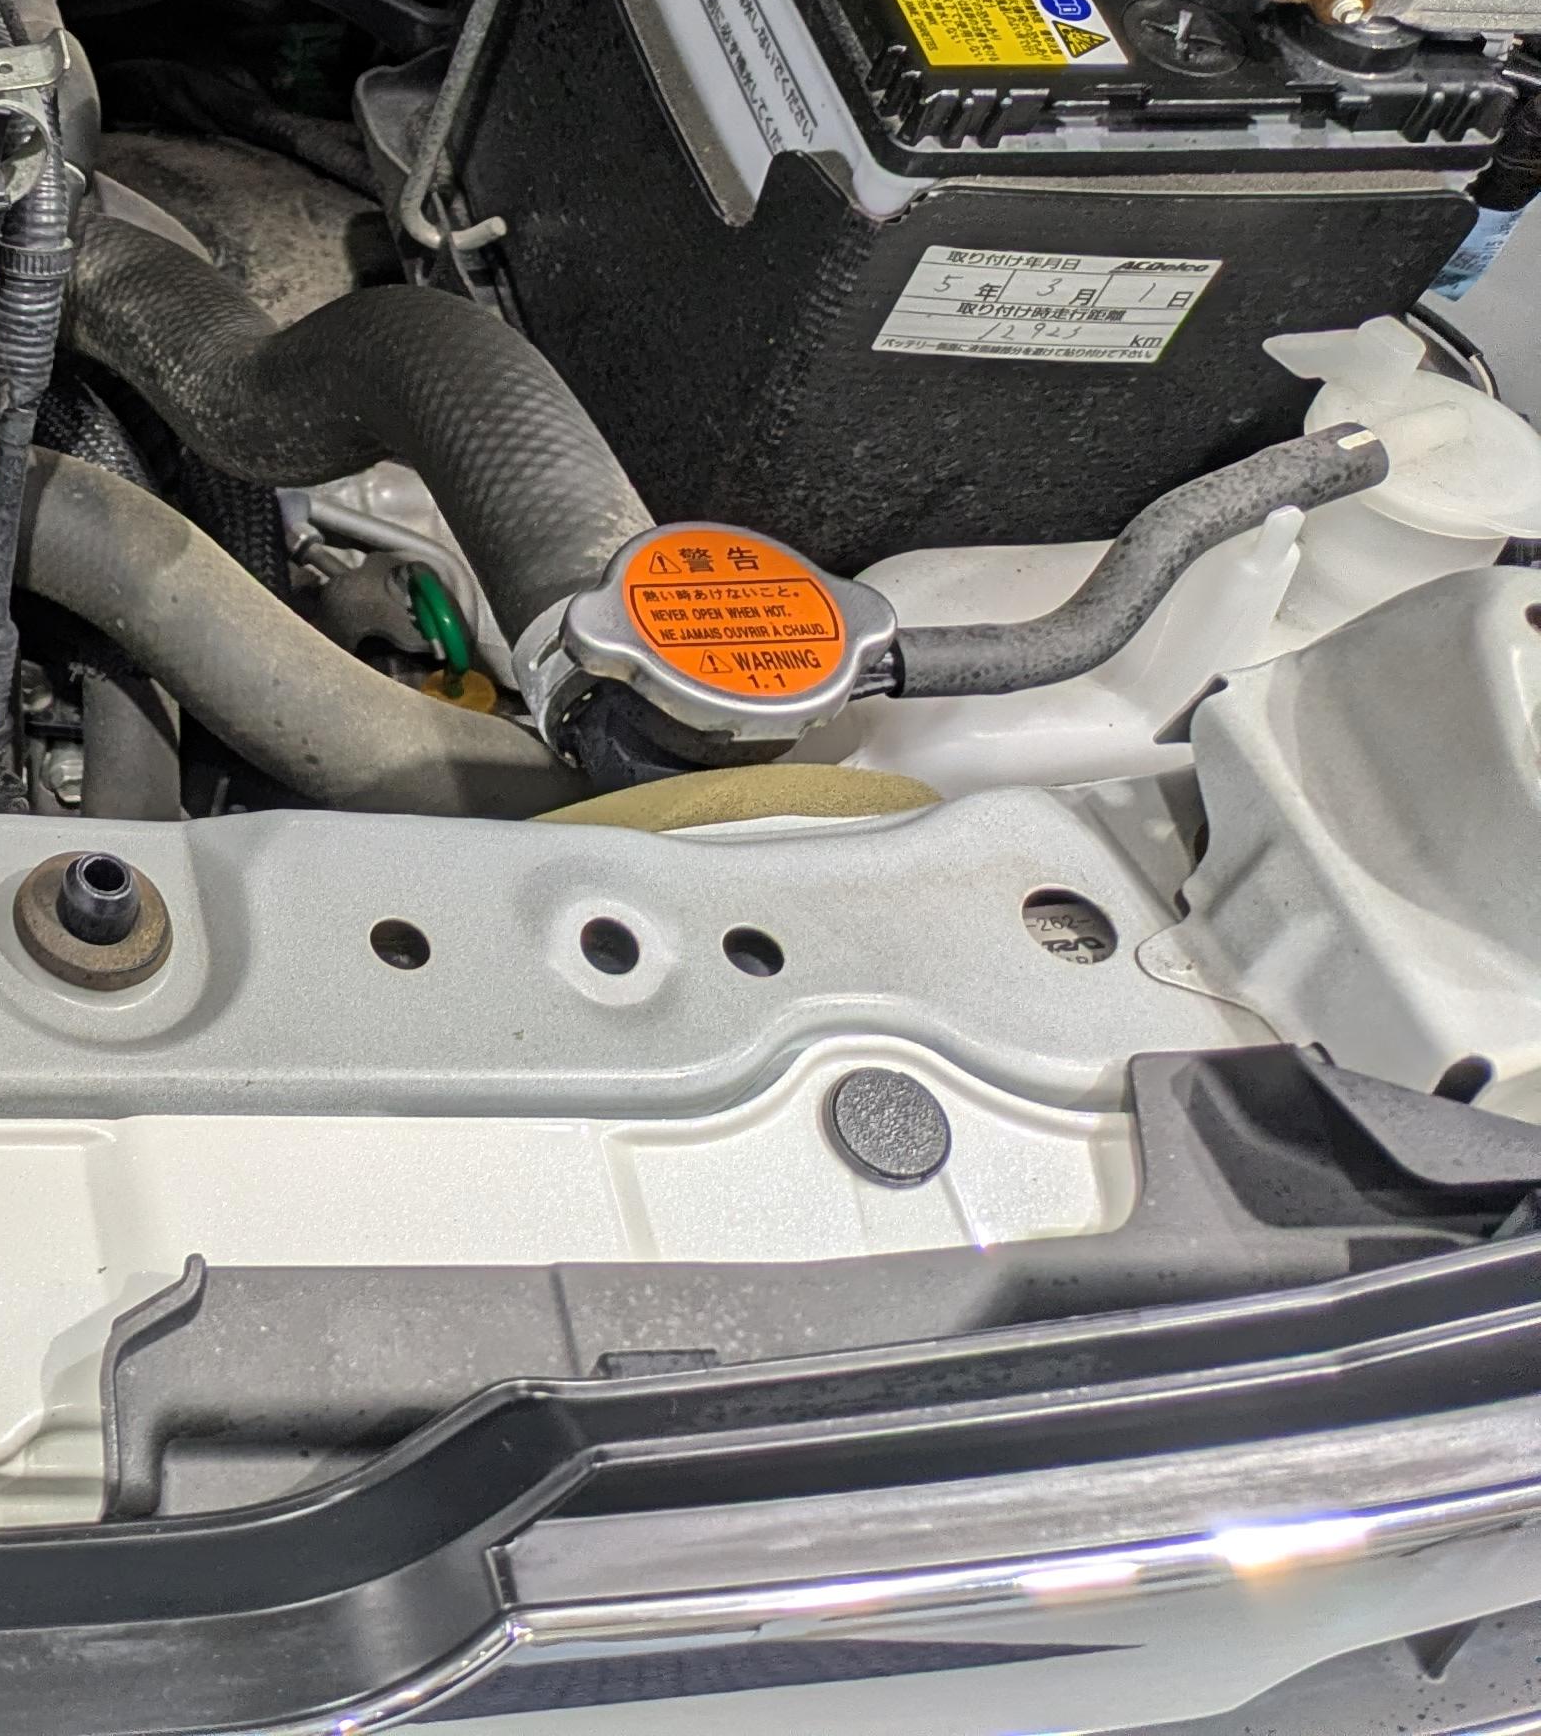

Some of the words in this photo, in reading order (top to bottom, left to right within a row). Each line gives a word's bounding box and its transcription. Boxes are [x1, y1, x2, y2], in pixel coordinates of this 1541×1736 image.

[947, 250, 1082, 271] 取り付け年月日
[933, 274, 963, 293] 5
[975, 284, 1001, 302] 年
[1036, 277, 1063, 296] 3
[1069, 287, 1096, 307] 月
[1166, 290, 1195, 309] 日
[957, 301, 1127, 322] 取り付け時走行距離
[1128, 334, 1165, 348] km
[678, 546, 760, 573] 警告
[642, 585, 800, 603] 熱い時あけないこと。
[650, 609, 689, 622] NEVER
[692, 607, 724, 621] OPEN
[726, 606, 761, 619] WHEN
[763, 604, 793, 618] HOT.
[659, 628, 679, 642] NE
[680, 627, 722, 640] JAMAIS
[723, 625, 769, 639] OUVRIR
[782, 623, 829, 636] CHAUD.
[731, 648, 822, 672] WARNING
